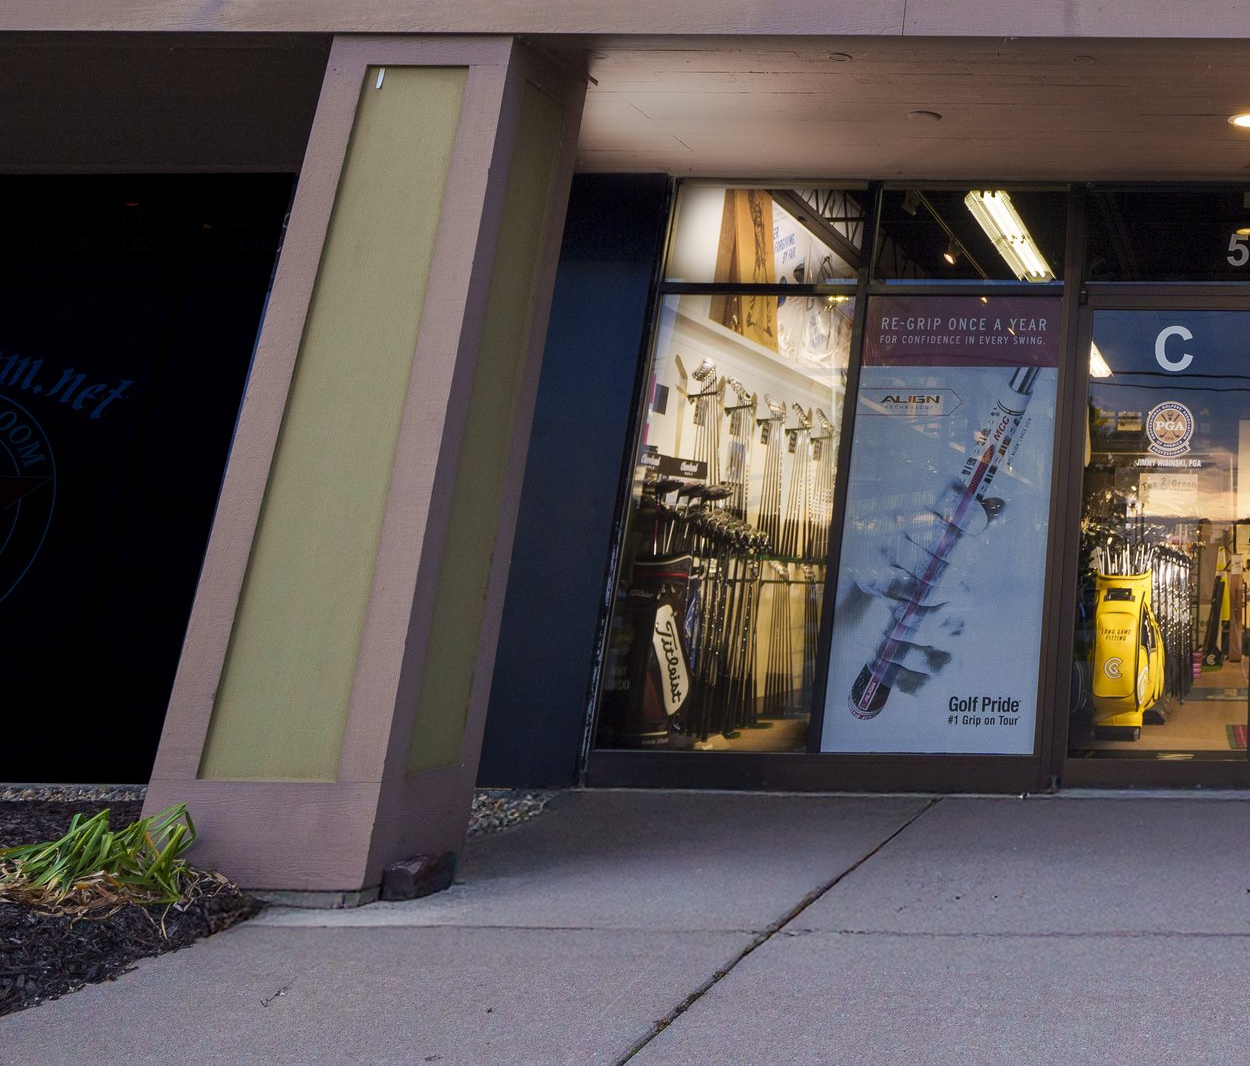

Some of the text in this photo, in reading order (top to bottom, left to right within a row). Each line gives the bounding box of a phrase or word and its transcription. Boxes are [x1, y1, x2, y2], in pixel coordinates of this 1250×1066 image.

[880, 317, 1047, 331] RE-GRIP ONCE A YEAR
[880, 335, 1046, 345] FOR CONFIDENCE IN EVERY SWING.
[1154, 325, 1194, 372] C
[880, 395, 940, 404] ALIGN
[993, 416, 1010, 441] MCC
[1155, 421, 1185, 431] PGA
[1188, 459, 1202, 468] PGA
[655, 621, 681, 704] Titleist
[949, 697, 1019, 713] Golf Pride
[948, 716, 1018, 726] #1 Grip on Tour
